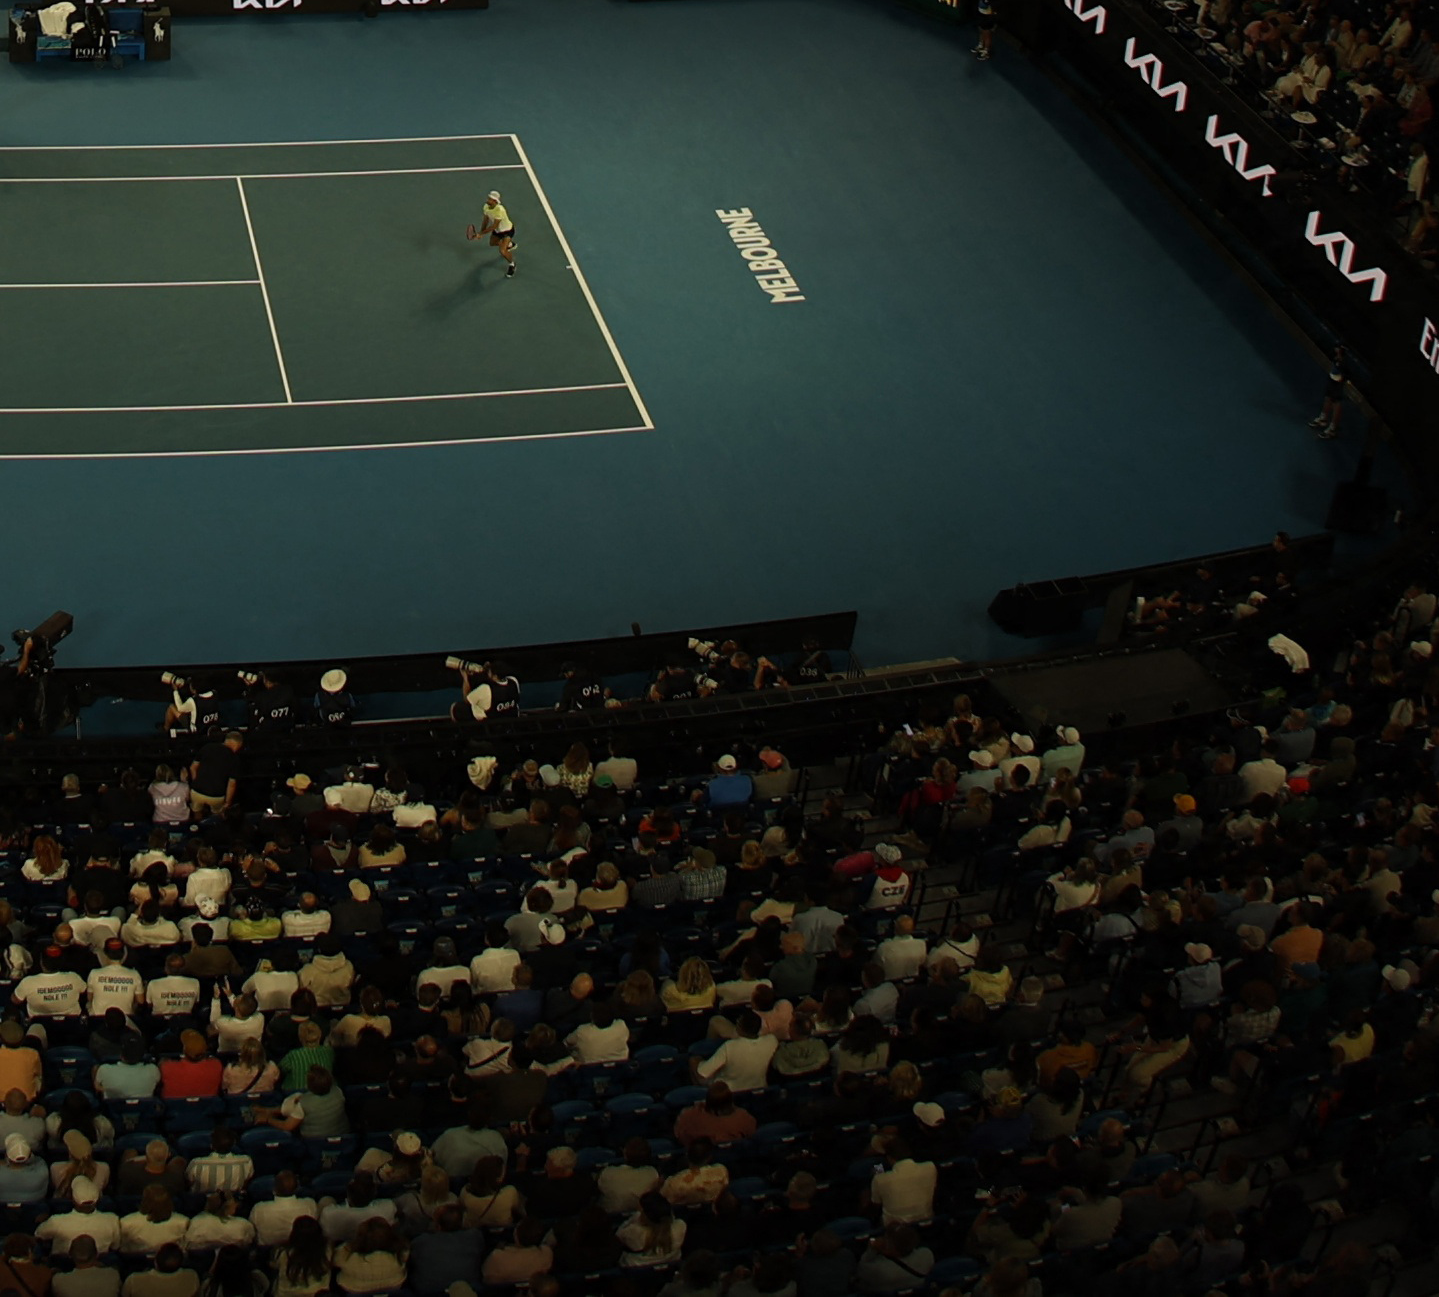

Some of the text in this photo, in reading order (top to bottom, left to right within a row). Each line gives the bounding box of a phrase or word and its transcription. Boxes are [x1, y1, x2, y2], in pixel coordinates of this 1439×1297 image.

[75, 47, 106, 56] POLO
[715, 207, 806, 303] MELBOURNE
[270, 706, 289, 718] 077
